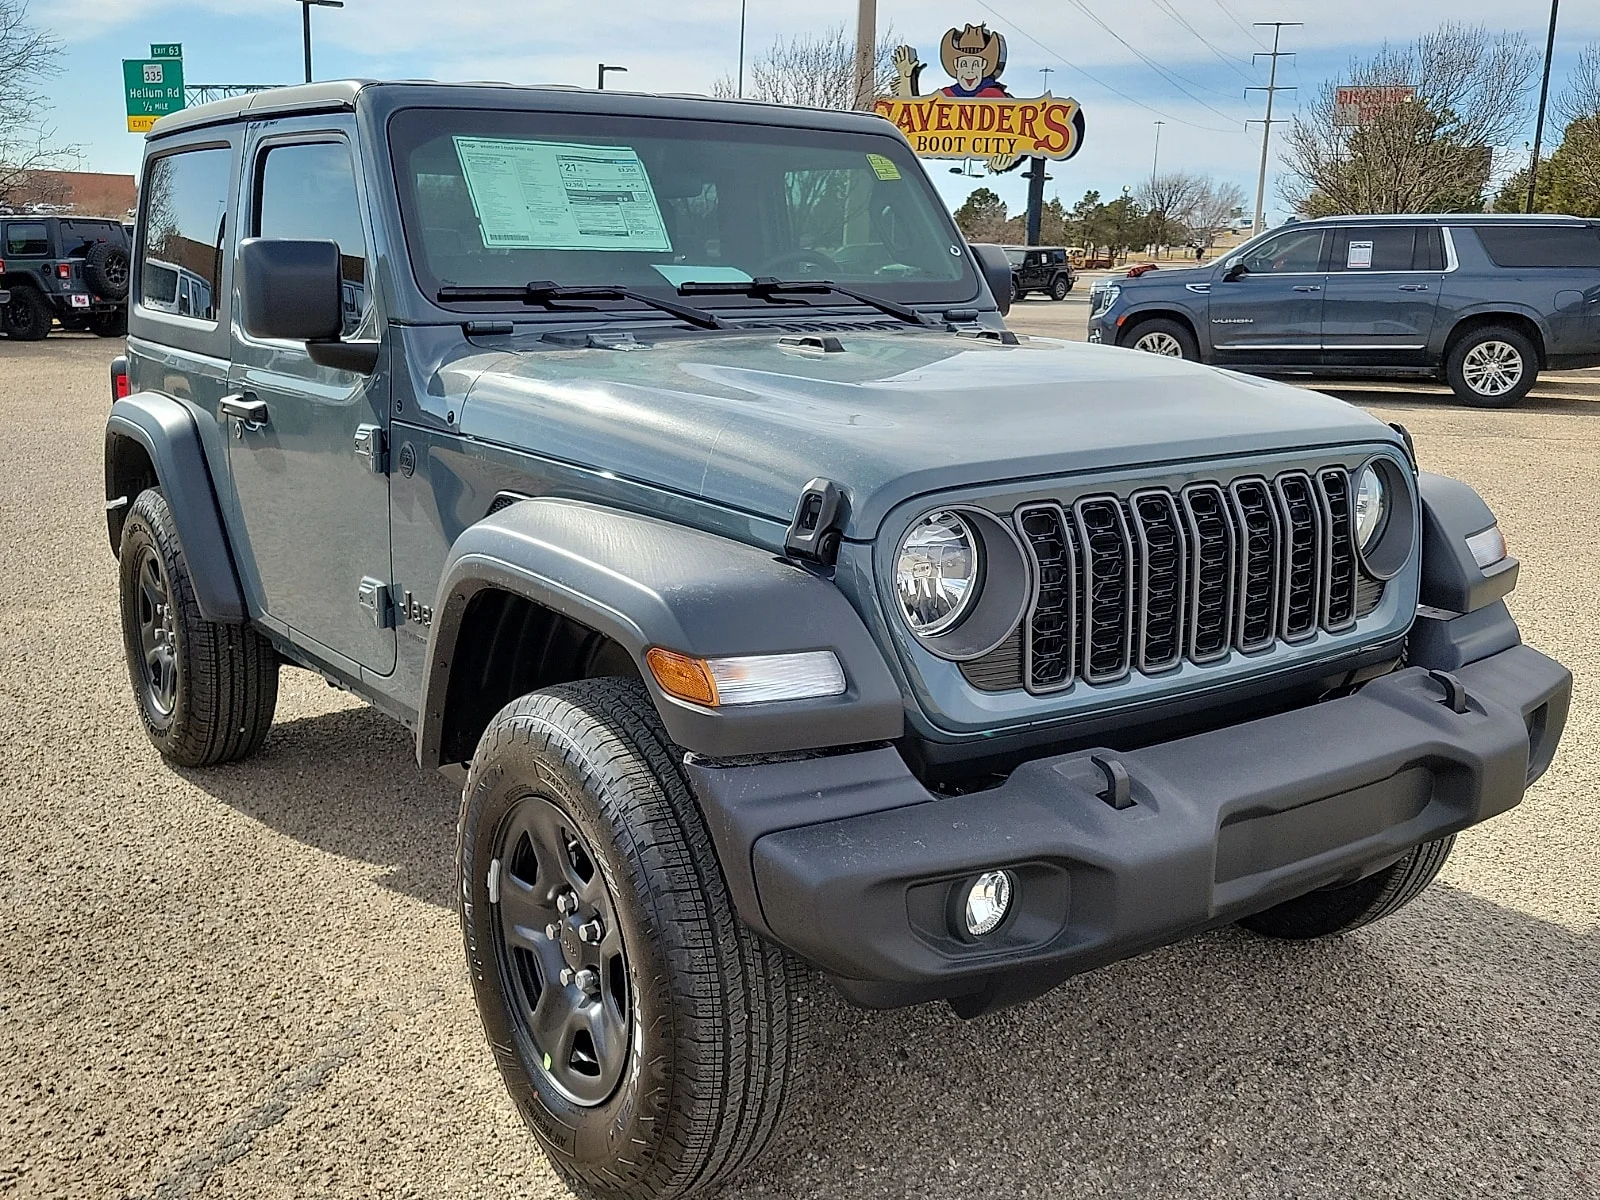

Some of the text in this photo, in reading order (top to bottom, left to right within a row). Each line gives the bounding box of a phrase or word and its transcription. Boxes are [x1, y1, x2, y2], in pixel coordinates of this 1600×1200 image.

[153, 46, 179, 56] EXIT 63
[144, 71, 162, 82] 335
[129, 86, 179, 98] Helium Rd
[154, 102, 169, 110] MILE
[917, 135, 1018, 154] BOOT CITY
[564, 163, 577, 172] 21
[399, 590, 434, 629] Jee
